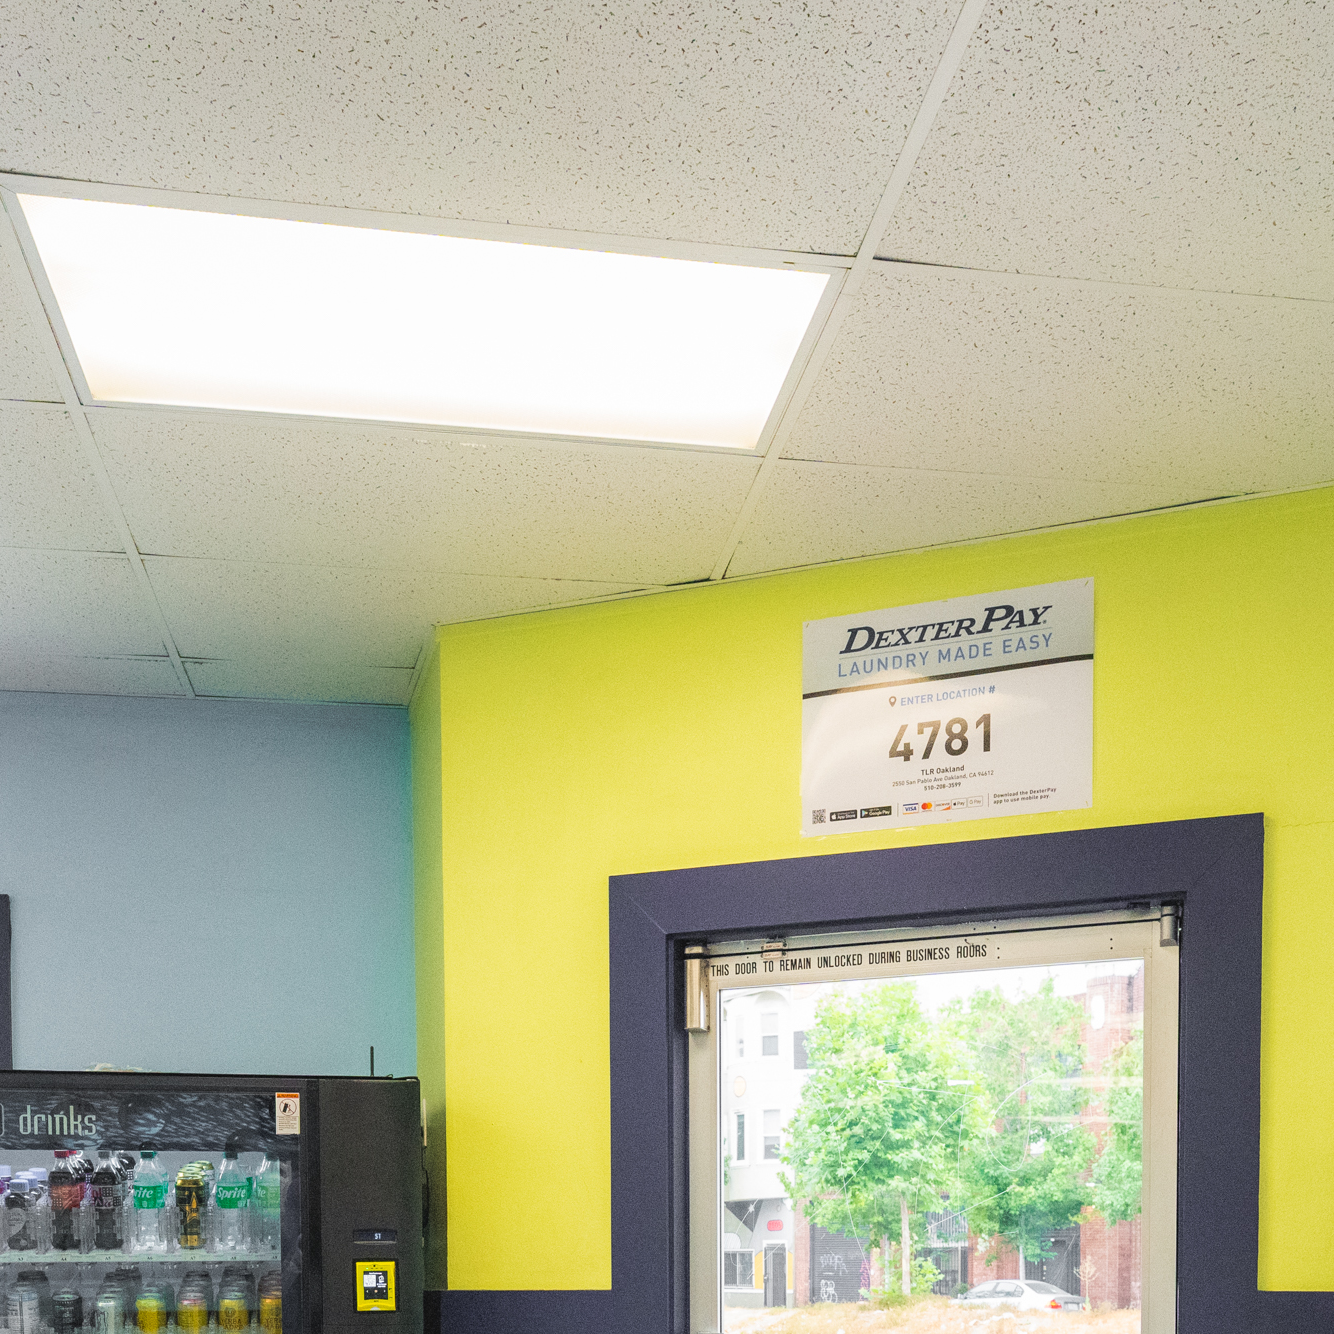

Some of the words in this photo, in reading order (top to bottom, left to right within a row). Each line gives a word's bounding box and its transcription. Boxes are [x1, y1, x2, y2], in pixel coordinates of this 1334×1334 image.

[838, 651, 929, 677] LAUNDRY
[938, 642, 993, 663] MADE
[1002, 633, 1053, 654] EASY
[901, 694, 933, 706] ENTER
[936, 687, 986, 702] LOCATION
[989, 685, 995, 694] #
[888, 713, 991, 762] 4781
[921, 767, 934, 776] TLR
[936, 765, 964, 775] Oakland
[944, 774, 967, 782] Oakland,
[711, 964, 729, 976] THIS
[735, 963, 757, 975] DOOR
[763, 960, 773, 973] TO
[780, 958, 811, 972] REMAIN
[818, 954, 862, 968] UNLOCKED
[869, 952, 901, 965] DURING
[907, 948, 949, 962] BUSINESS
[19, 1105, 96, 1136] drinks
[218, 1187, 246, 1203] Sprite
